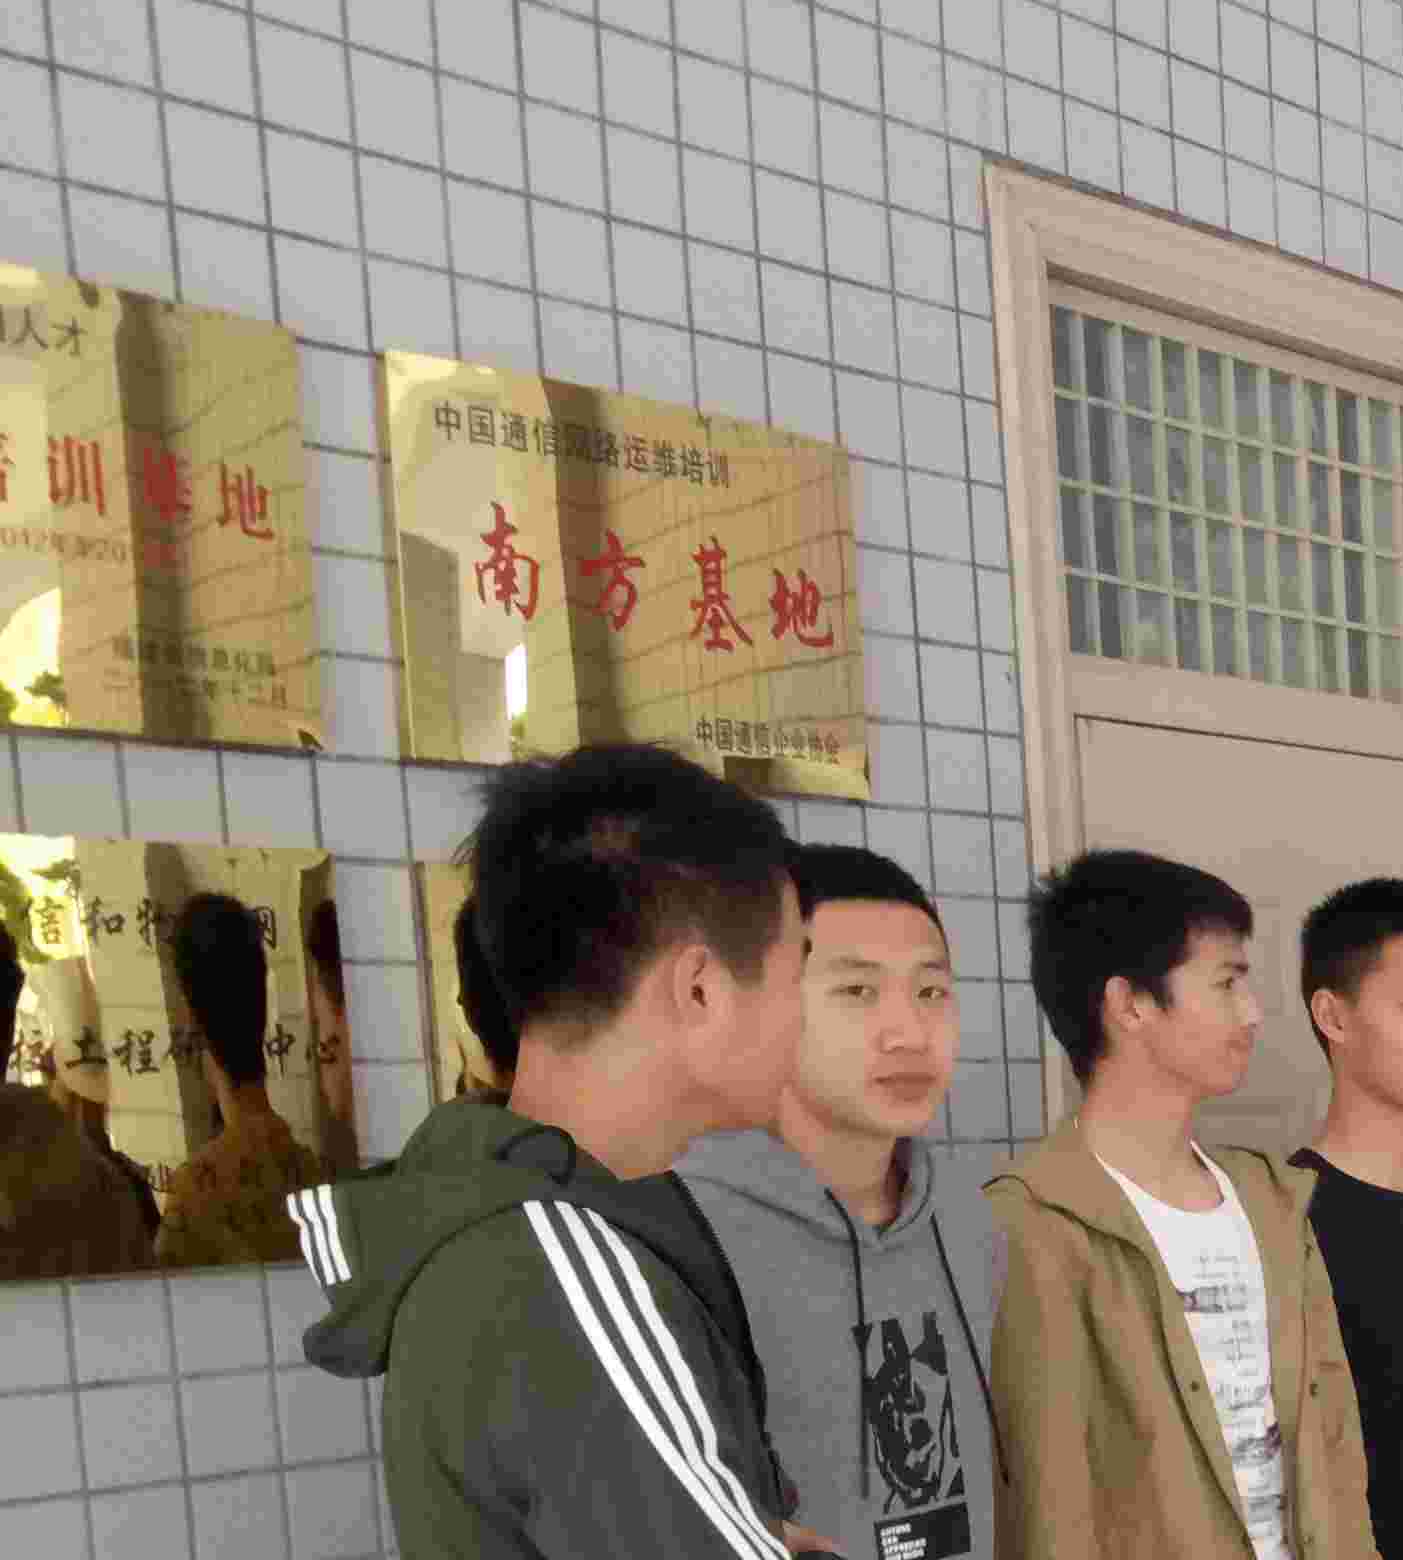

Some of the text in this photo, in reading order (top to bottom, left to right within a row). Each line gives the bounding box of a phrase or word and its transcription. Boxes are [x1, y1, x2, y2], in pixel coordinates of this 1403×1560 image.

[435, 401, 729, 489] 中国通信网络运维培训
[473, 500, 835, 655] 南方基地
